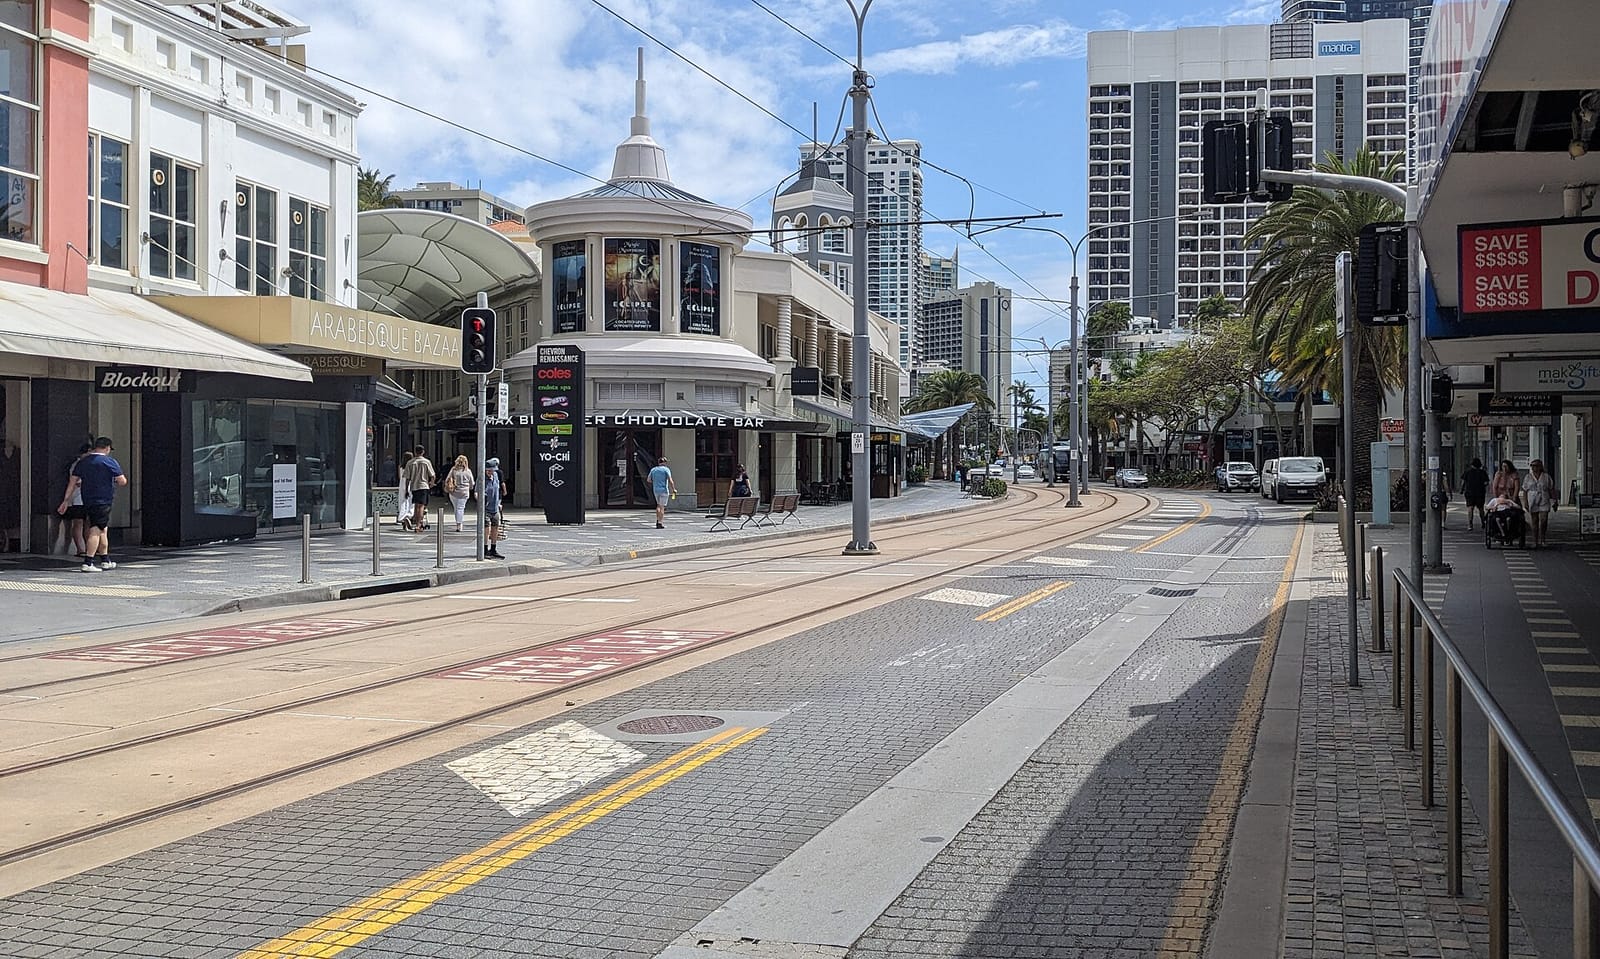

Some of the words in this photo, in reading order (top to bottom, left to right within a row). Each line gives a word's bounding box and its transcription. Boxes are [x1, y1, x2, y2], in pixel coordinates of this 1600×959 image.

[1321, 43, 1353, 53] mantra
[1475, 234, 1529, 252] SAVE
[1475, 251, 1529, 269] $$$$$
[1475, 274, 1529, 292] SAVE
[1475, 291, 1529, 309] $$$$$
[310, 312, 409, 353] ARABESQUE
[414, 329, 460, 357] BAZAA
[540, 347, 566, 355] CHEVRON
[300, 355, 367, 369] RABESQUE
[540, 355, 579, 363] RENAISSANCE
[101, 371, 182, 388] Blockout
[538, 367, 571, 379] coles
[485, 415, 514, 426] MAX
[614, 415, 727, 428] CHOCOLATE
[733, 417, 764, 428] BAR
[442, 654, 635, 683] KEEP
[543, 629, 727, 655] CLEAR
